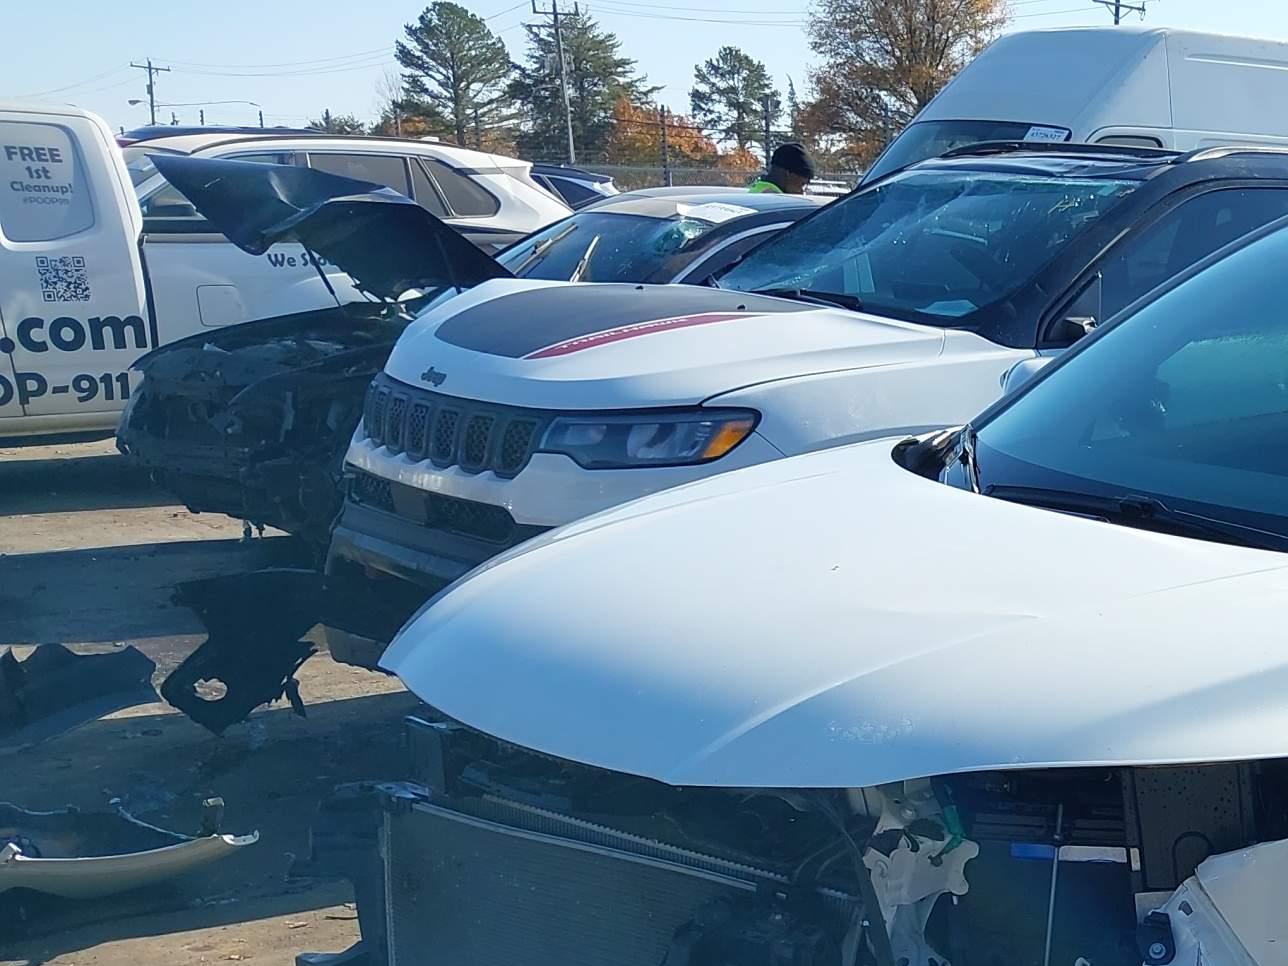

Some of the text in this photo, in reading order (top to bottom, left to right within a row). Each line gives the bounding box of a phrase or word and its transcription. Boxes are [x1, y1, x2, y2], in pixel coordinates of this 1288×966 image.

[4, 146, 63, 163] FREE
[25, 166, 52, 180] 1st
[10, 181, 73, 195] Cleanup!
[267, 253, 296, 267] We
[0, 315, 147, 353] .com
